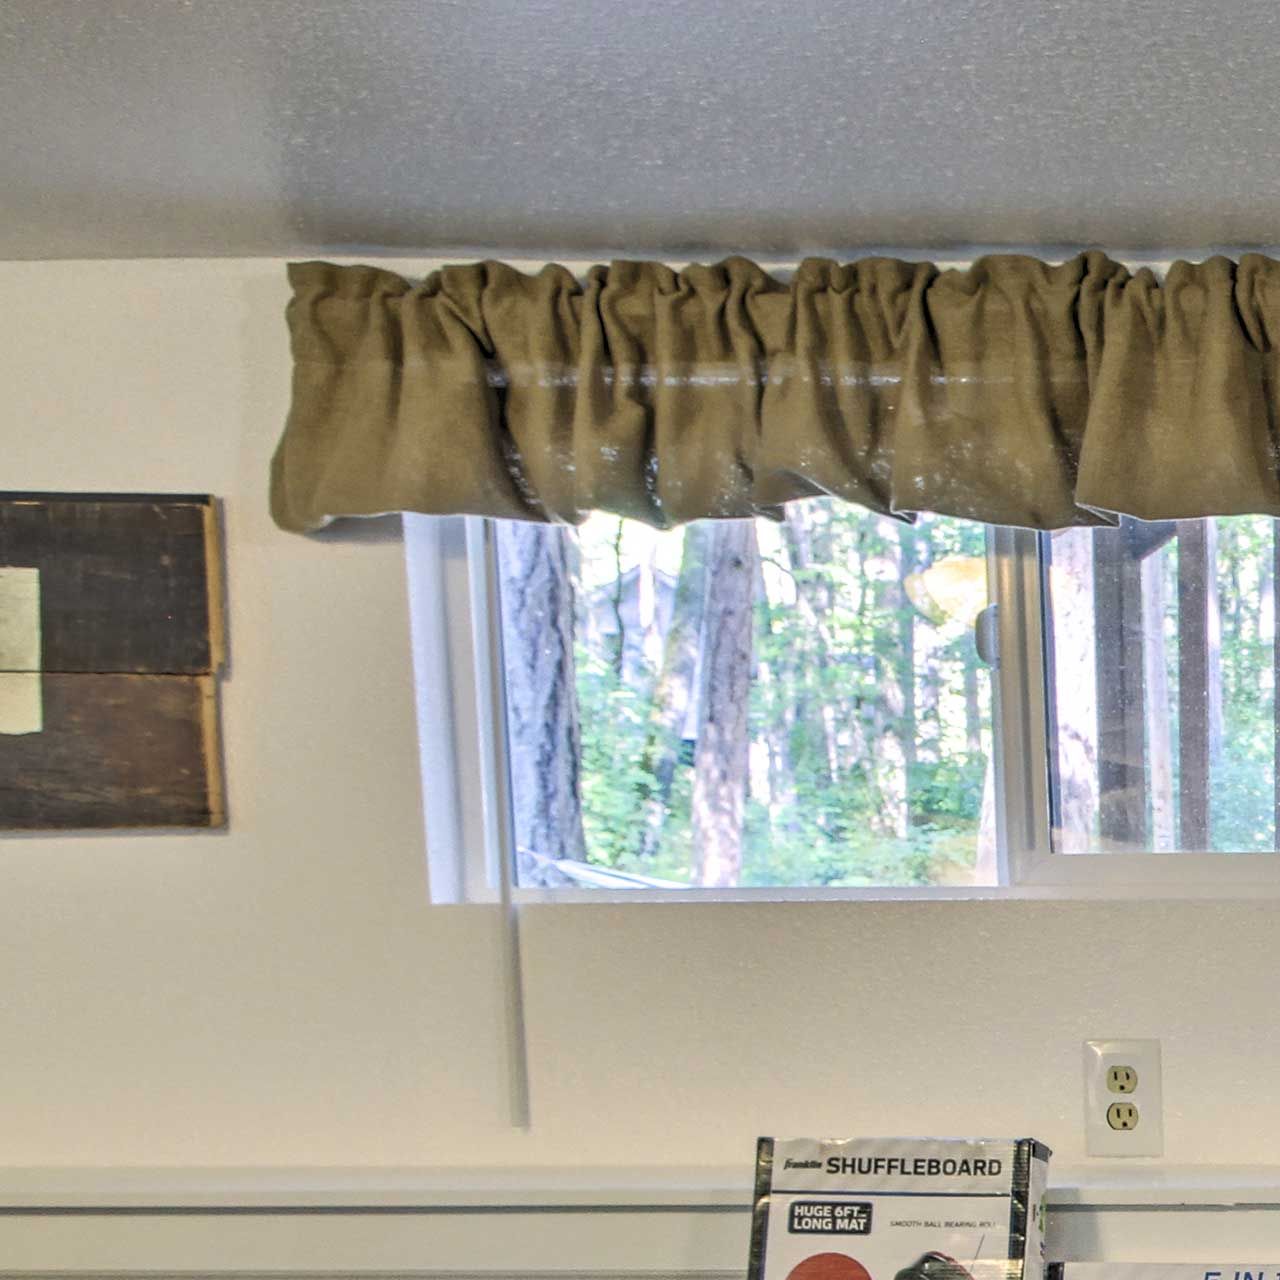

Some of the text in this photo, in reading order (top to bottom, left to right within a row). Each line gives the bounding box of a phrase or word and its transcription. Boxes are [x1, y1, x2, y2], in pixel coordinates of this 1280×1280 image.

[826, 1157, 1001, 1176] SHUFFLEBOARD
[794, 1205, 833, 1218] HUGE
[794, 1218, 867, 1231] LONG MAT
